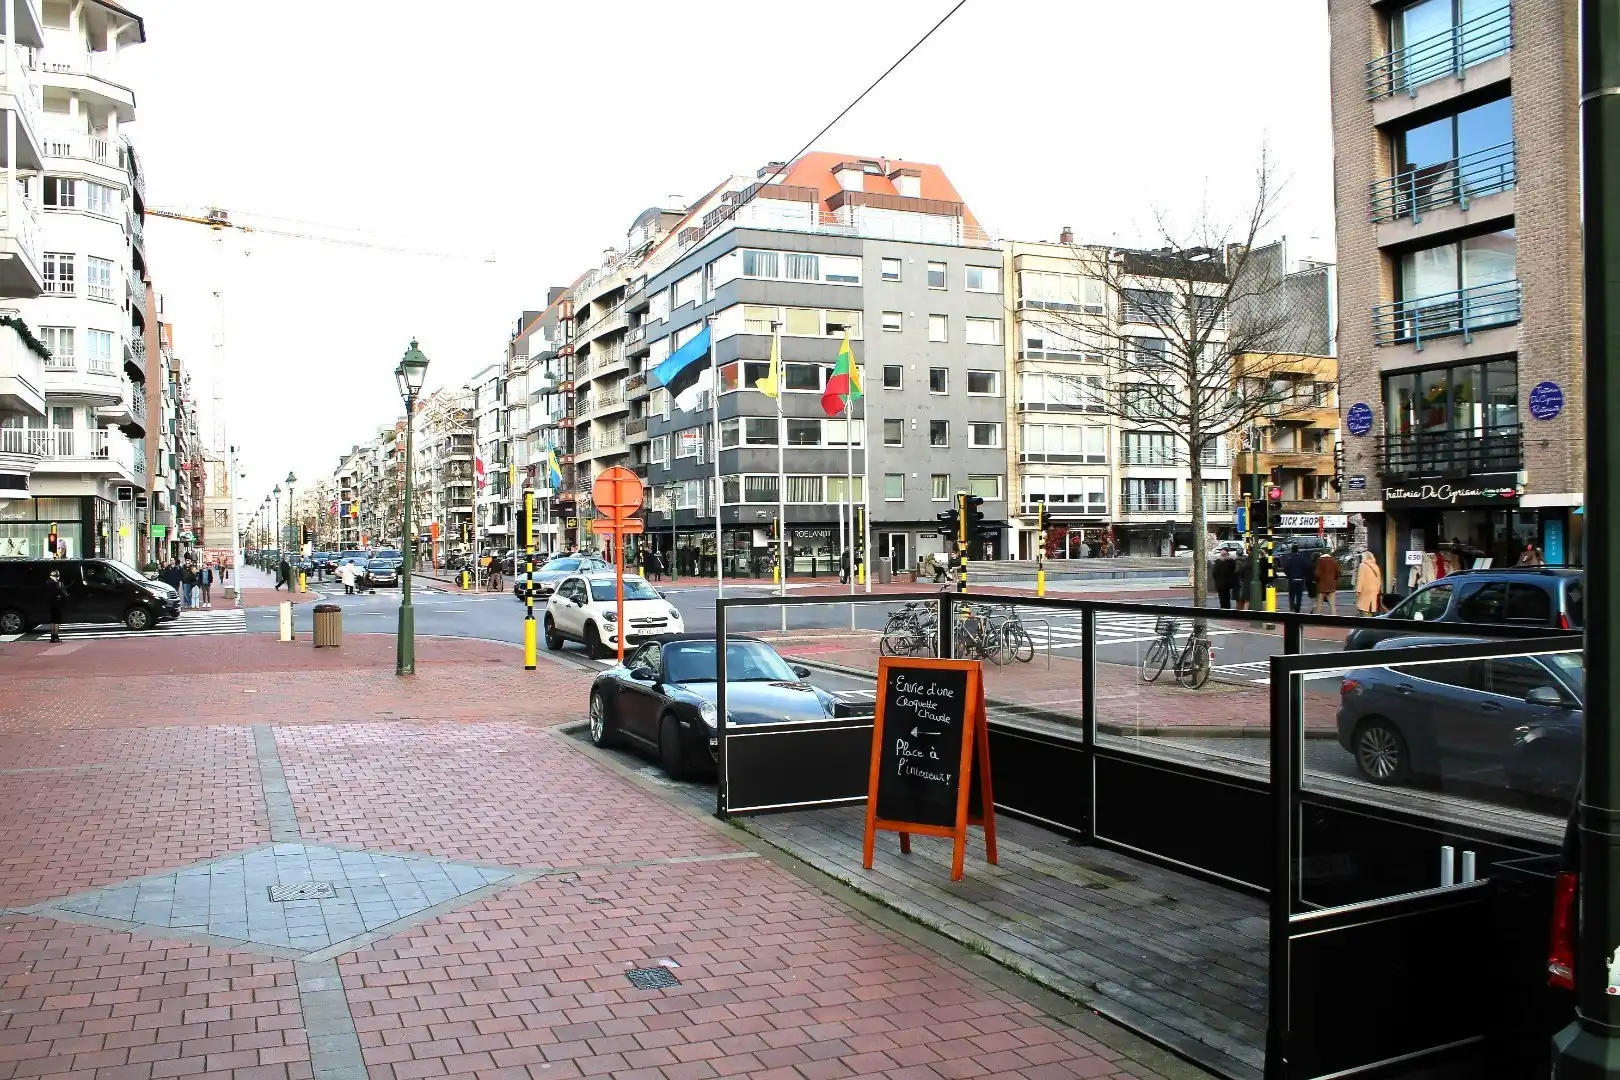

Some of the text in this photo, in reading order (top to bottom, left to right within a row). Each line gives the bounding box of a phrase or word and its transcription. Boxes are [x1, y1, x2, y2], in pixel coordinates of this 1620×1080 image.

[1382, 485, 1481, 503] Trattoria Da Cipriani
[1280, 516, 1319, 526] UICK SHOP
[896, 675, 954, 698] Envie d'une
[896, 738, 940, 760] Place à
